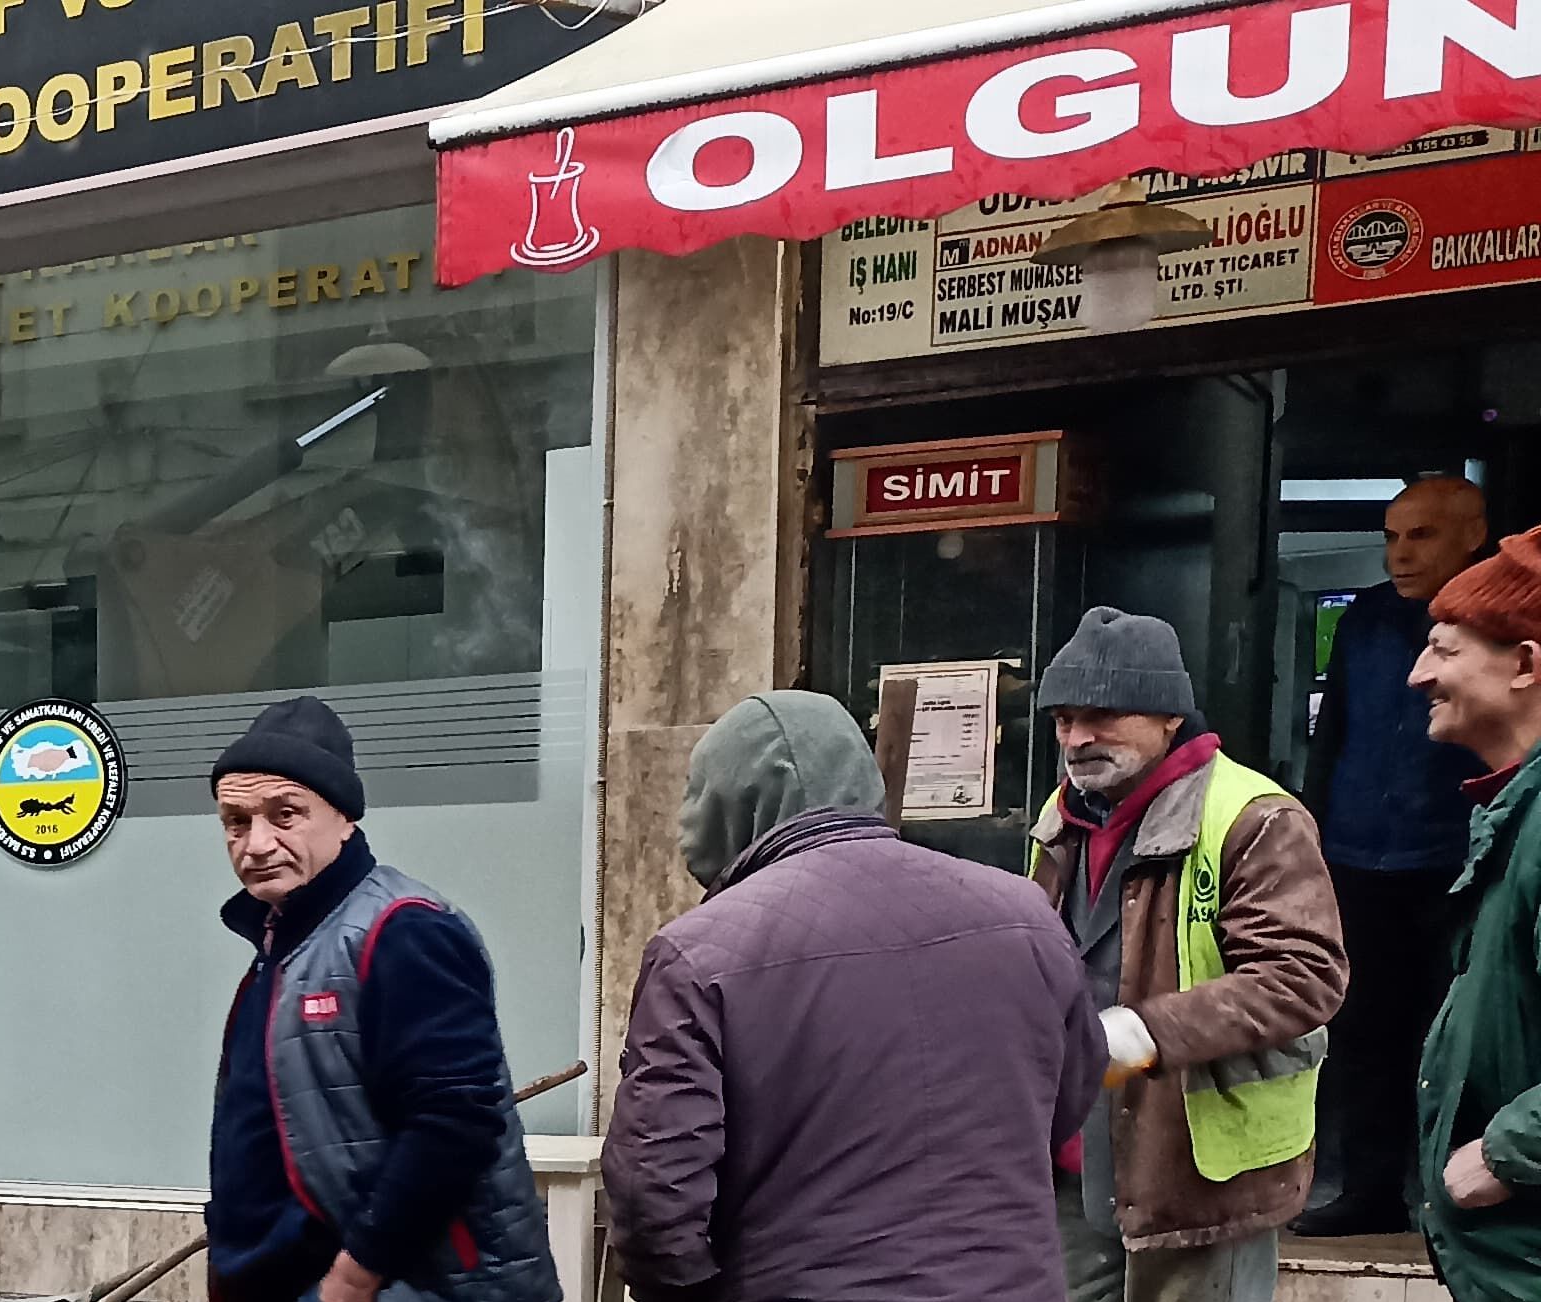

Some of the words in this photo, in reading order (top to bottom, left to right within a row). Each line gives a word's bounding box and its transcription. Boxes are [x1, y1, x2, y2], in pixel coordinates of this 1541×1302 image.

[645, 0, 1541, 213] OLGUN
[972, 232, 1043, 260] ADNAN
[1432, 224, 1540, 270] BAKKALLAR
[872, 250, 917, 284] HANI
[103, 251, 420, 329] KOOPERAT
[937, 271, 1005, 302] SERBEST
[849, 300, 914, 326] No:19/C
[939, 300, 993, 334] MALİ
[1002, 294, 1082, 330] MÜŞAV
[883, 464, 1011, 502] SİMİT
